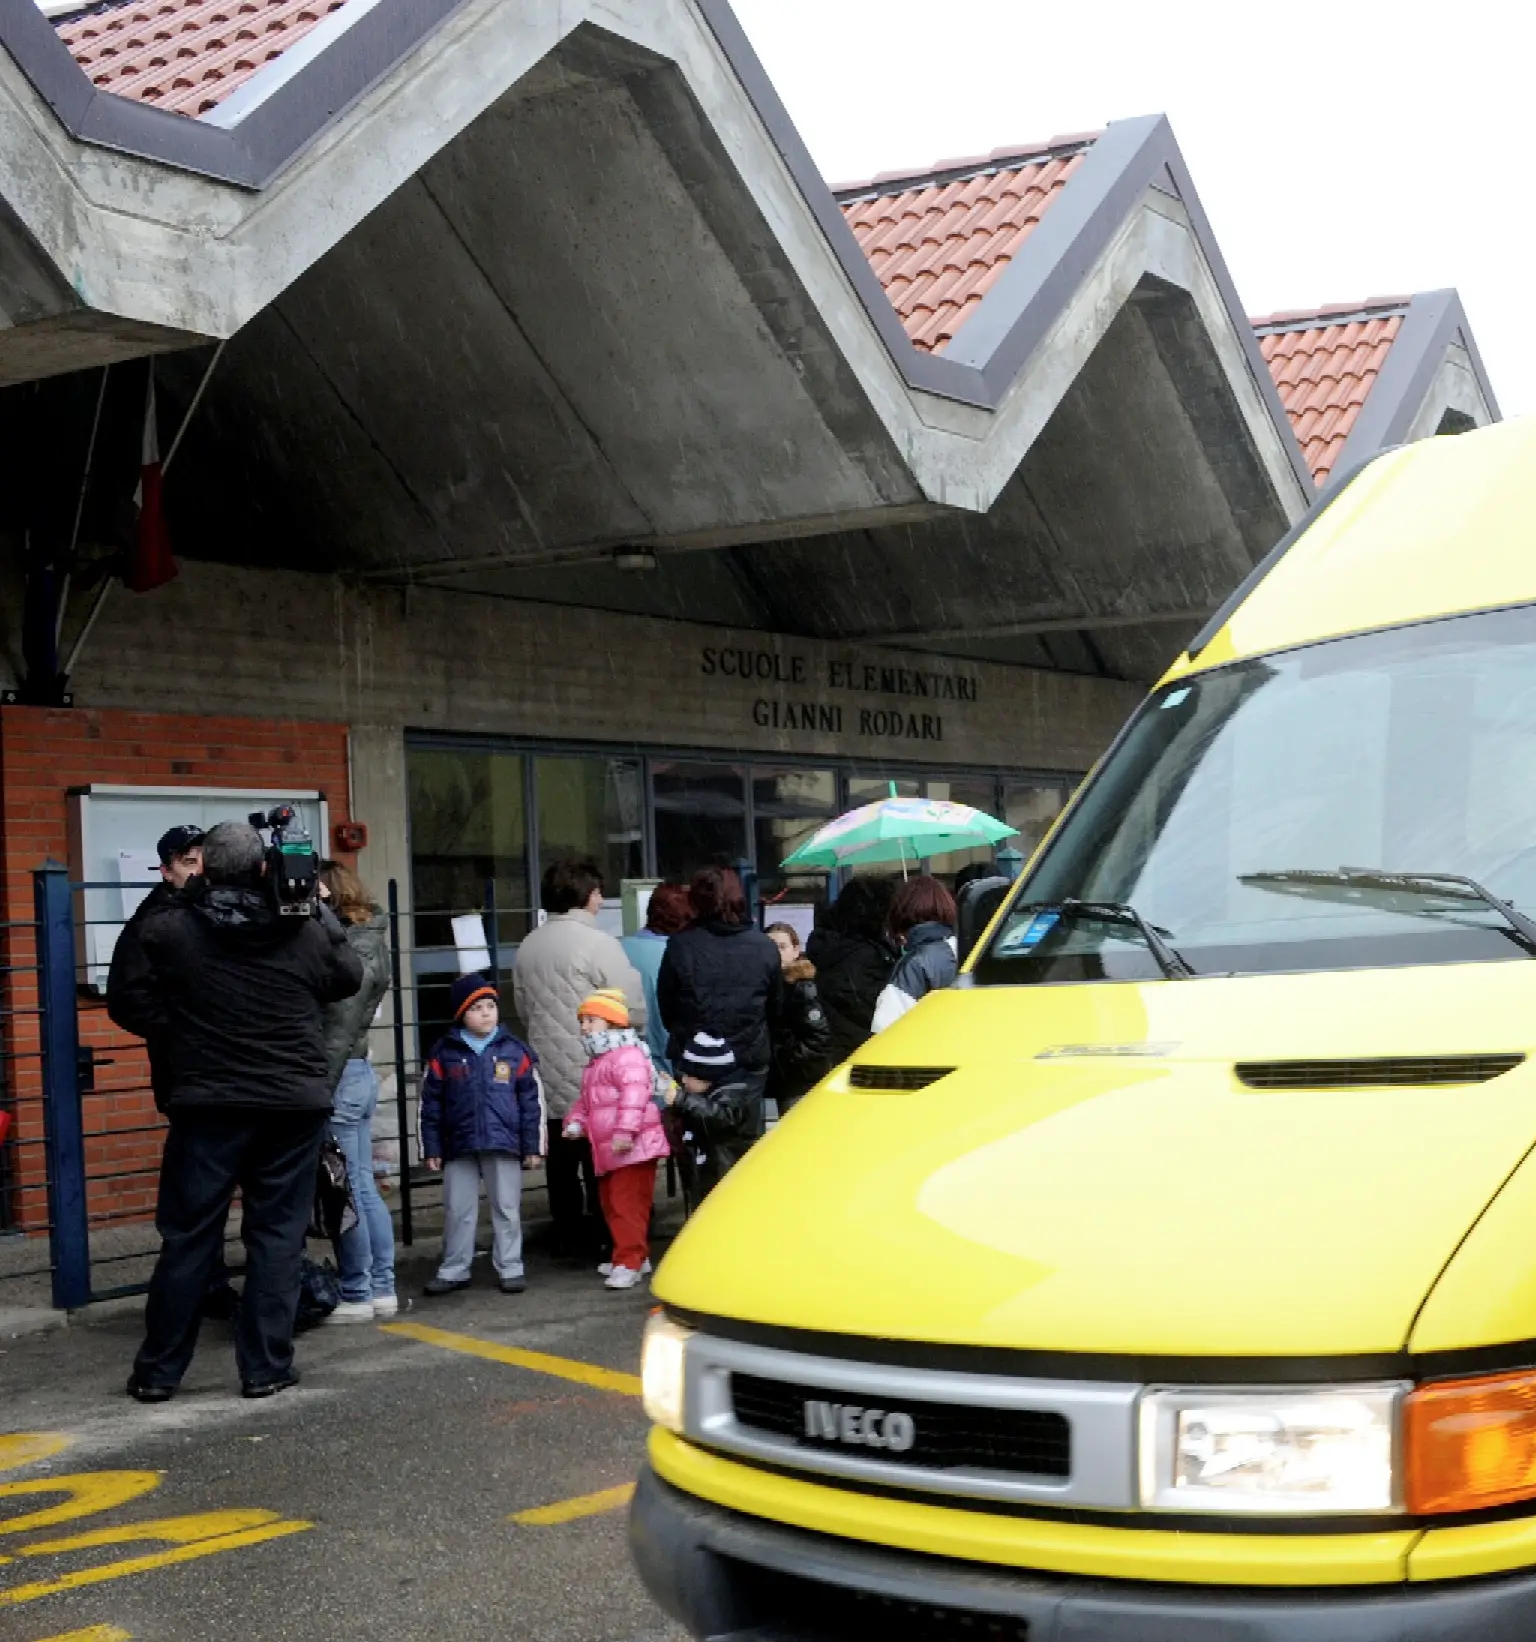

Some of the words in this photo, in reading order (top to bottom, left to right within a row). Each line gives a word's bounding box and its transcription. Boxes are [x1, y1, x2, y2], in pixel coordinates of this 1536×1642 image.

[701, 646, 806, 685] SCUOLE
[828, 659, 979, 703] ELEMENTARI
[753, 699, 843, 733] GIANNI
[859, 707, 944, 741] RODARI
[803, 1399, 916, 1452] IVECO
